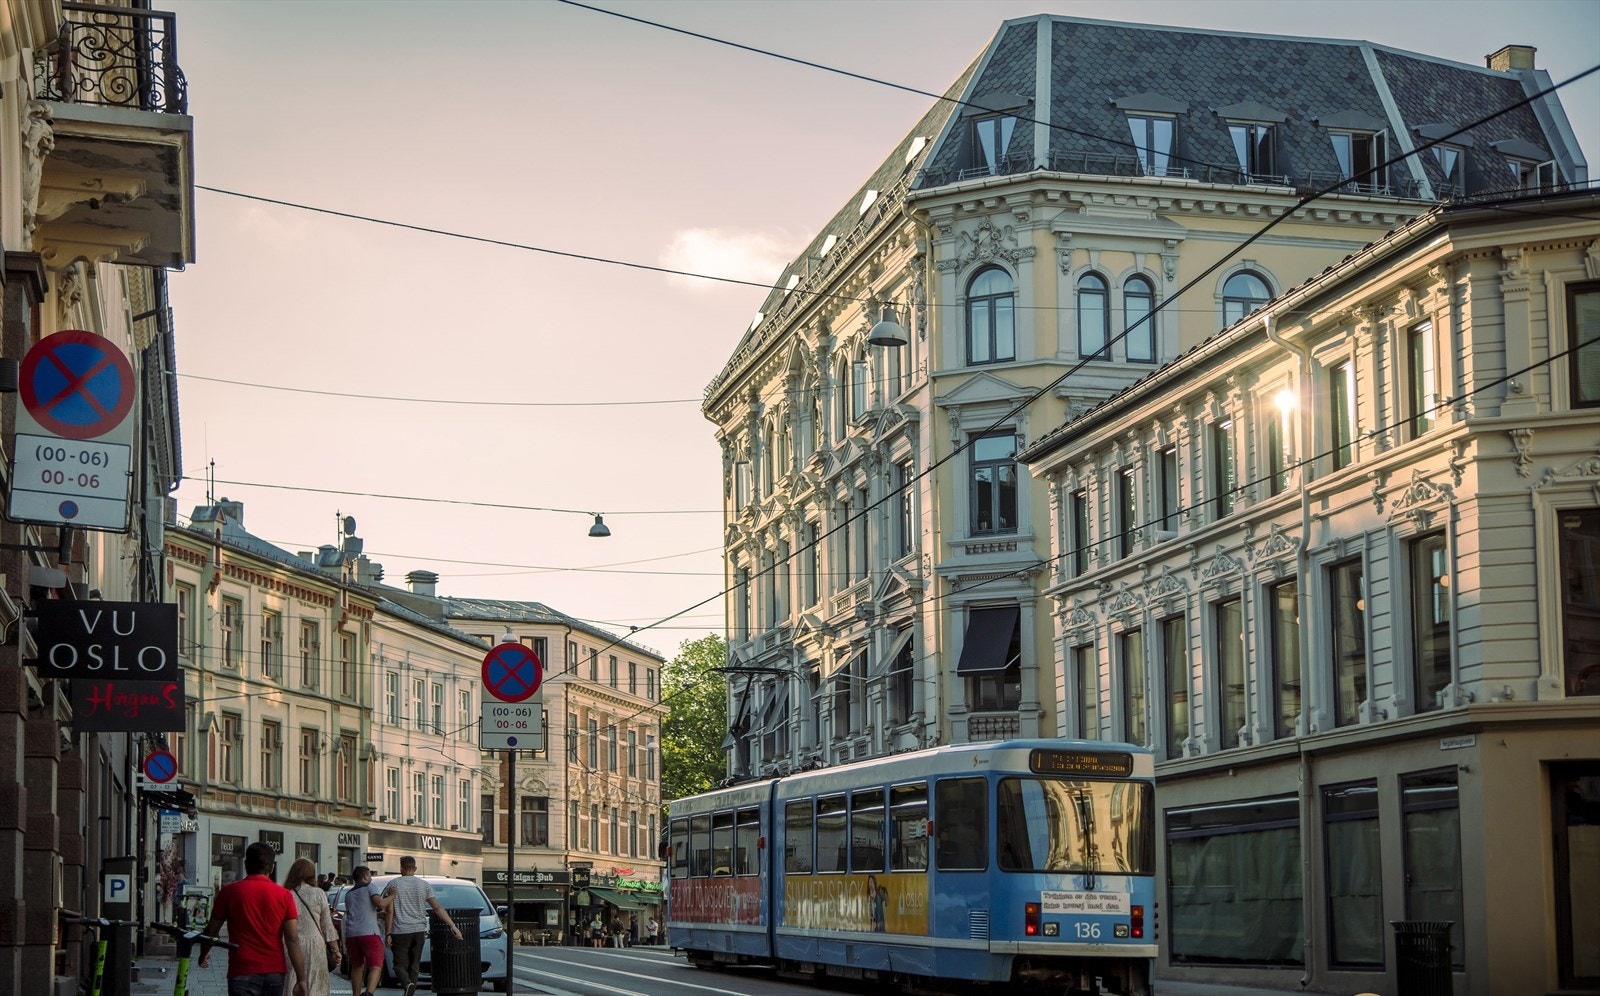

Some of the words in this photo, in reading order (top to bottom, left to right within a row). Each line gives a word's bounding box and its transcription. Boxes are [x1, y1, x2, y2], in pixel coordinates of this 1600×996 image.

[79, 609, 136, 636] VU
[49, 643, 167, 672] OSLO
[337, 833, 361, 846] GANNI
[421, 836, 442, 850] VOLT
[496, 872, 535, 882] Trfalgar
[536, 872, 554, 882] Pub
[110, 878, 126, 898] P
[786, 880, 824, 913] SUMMER
[826, 880, 835, 912] IS
[837, 880, 865, 913] BACK
[905, 892, 924, 908] OSLO
[1074, 922, 1101, 938] 136
